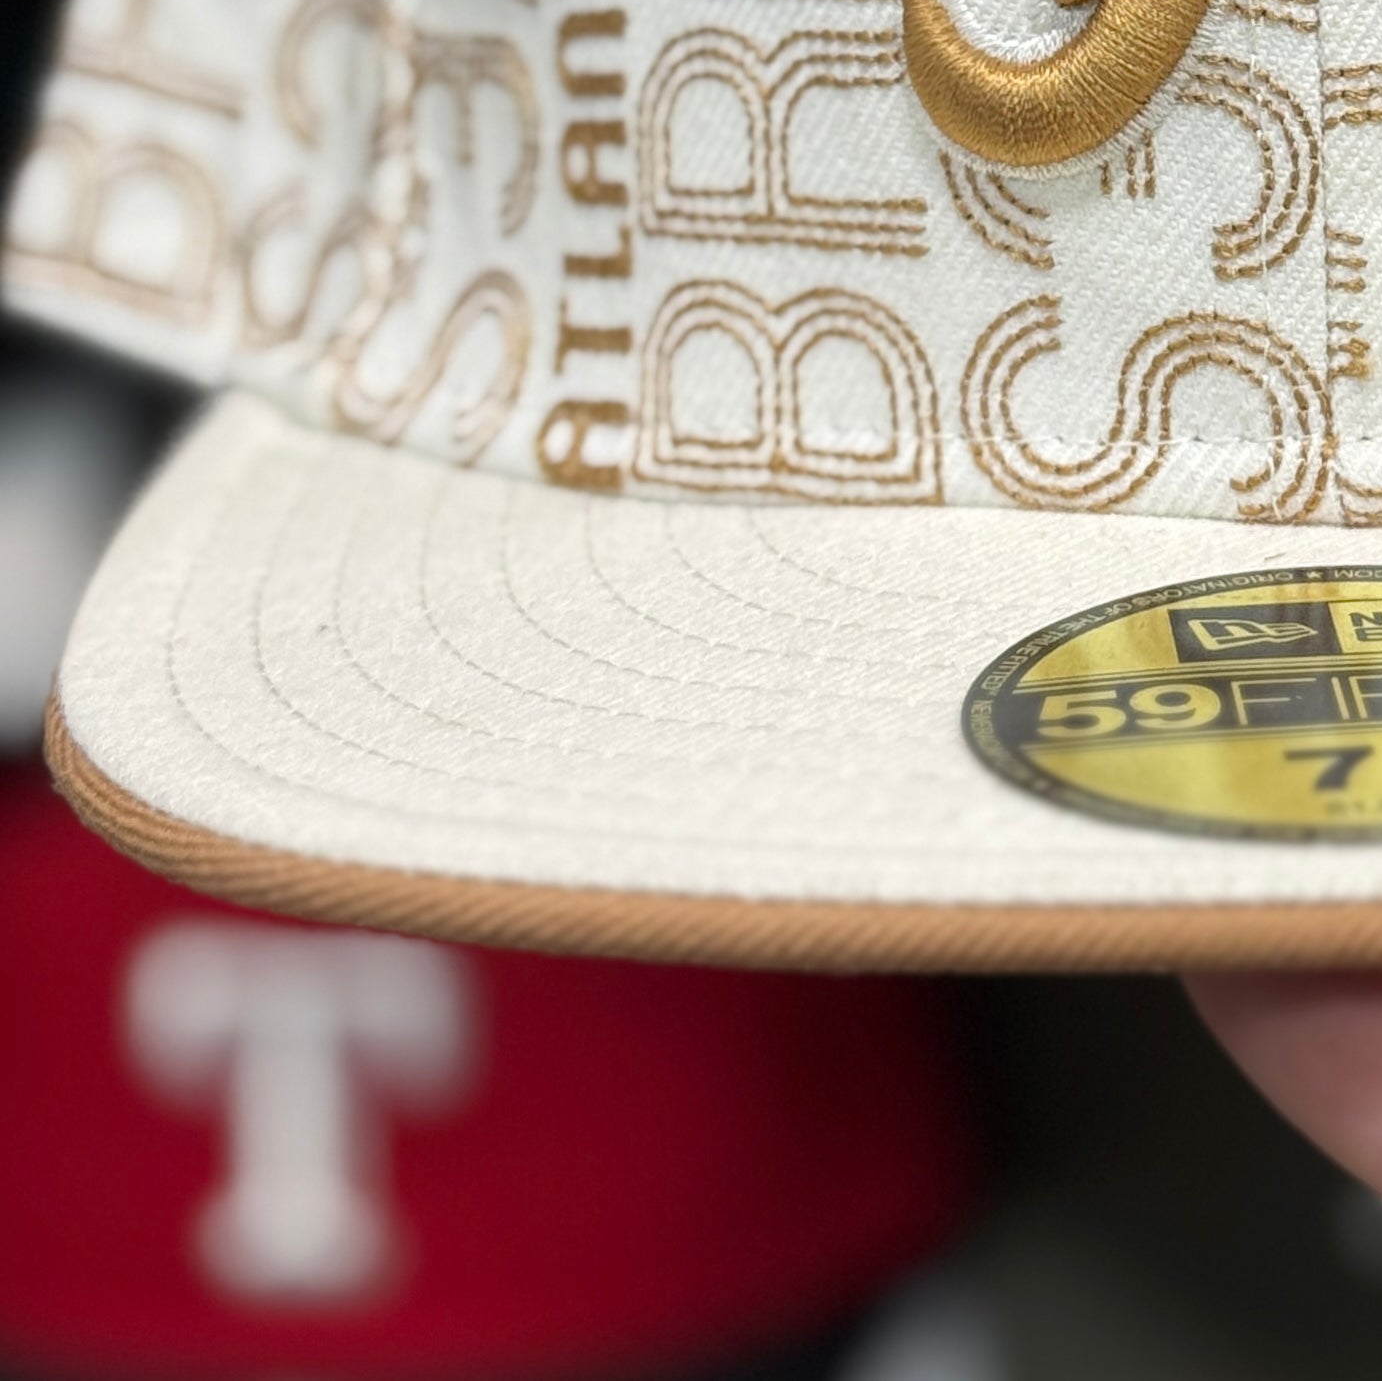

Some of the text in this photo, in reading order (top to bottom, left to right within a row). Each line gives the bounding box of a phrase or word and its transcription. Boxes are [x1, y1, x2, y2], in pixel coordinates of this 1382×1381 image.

[1132, 570, 1294, 606] ORIGINATORS
[1016, 627, 1071, 657] TRUE
[1282, 744, 1376, 792] 7
